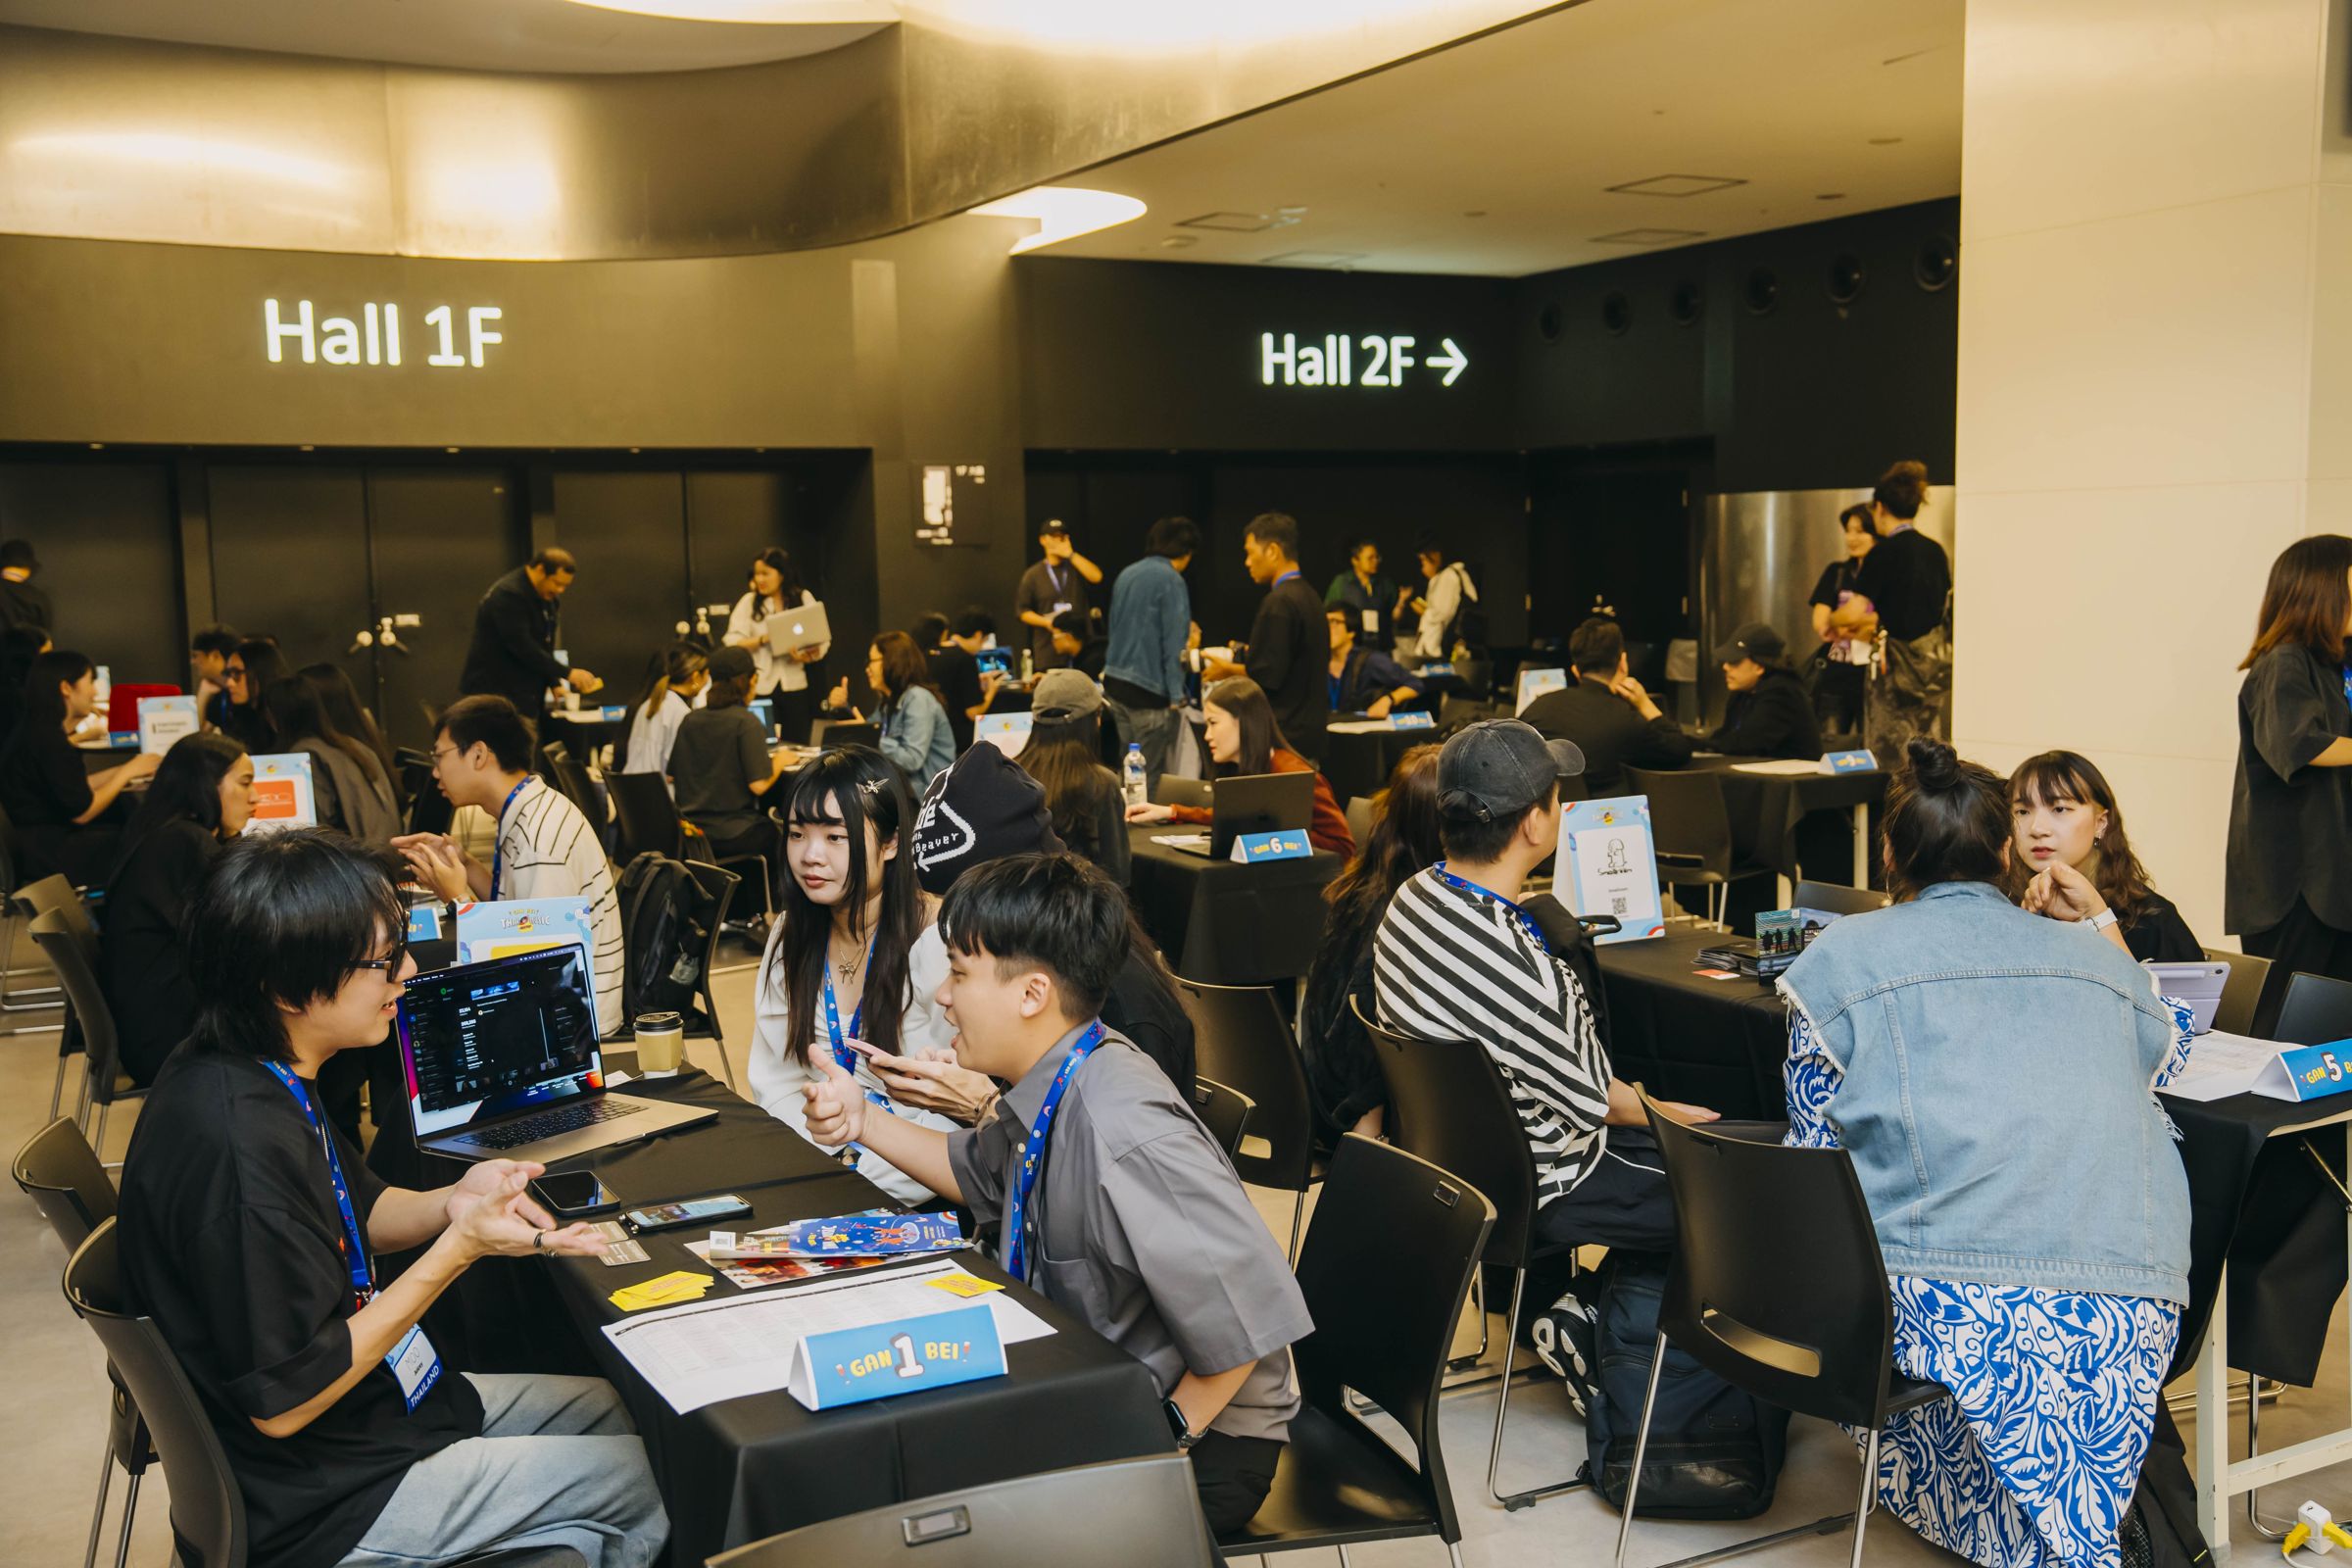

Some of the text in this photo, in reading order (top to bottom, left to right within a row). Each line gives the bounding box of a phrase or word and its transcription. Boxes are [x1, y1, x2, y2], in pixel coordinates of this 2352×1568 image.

[265, 298, 503, 368] Hall 1F
[1261, 332, 1416, 387] Hall 2F
[1269, 837, 1283, 854] 6
[2306, 1066, 2328, 1084] GAN
[2321, 1052, 2342, 1082] 5
[850, 1349, 893, 1377] GAN
[891, 1333, 925, 1378] 1
[411, 1365, 440, 1407] THAILAND
